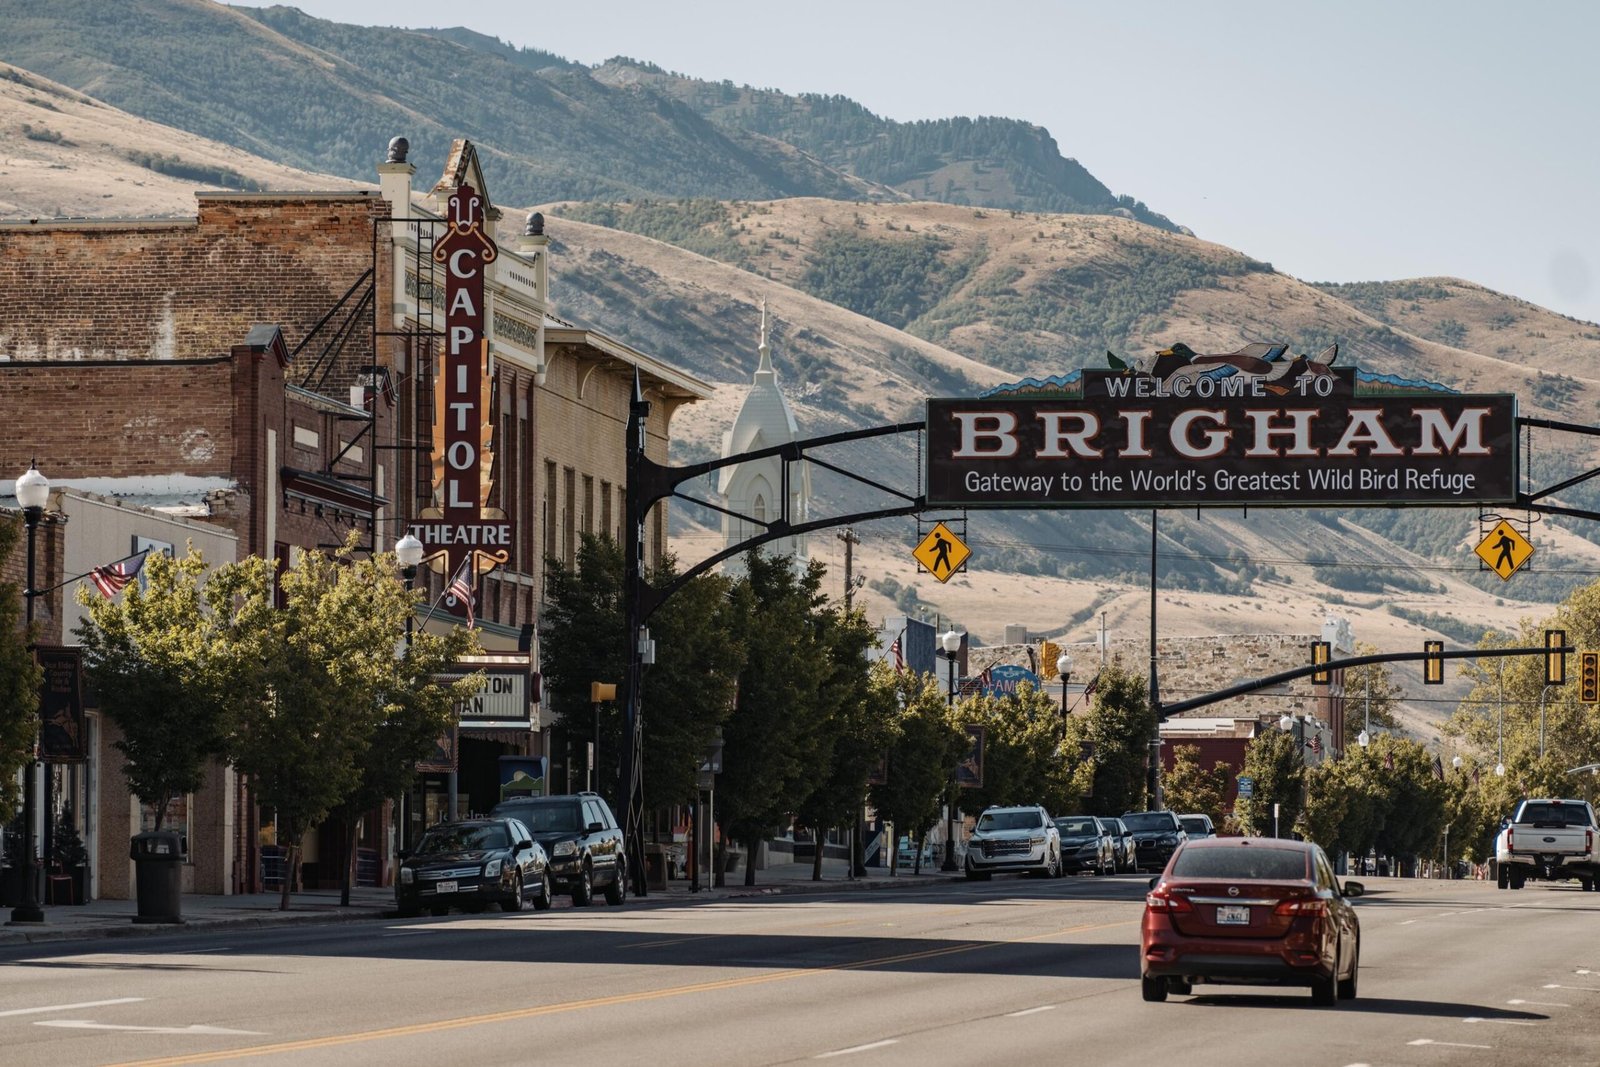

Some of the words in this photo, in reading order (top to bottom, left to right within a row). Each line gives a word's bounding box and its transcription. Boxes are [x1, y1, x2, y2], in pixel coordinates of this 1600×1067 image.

[448, 248, 477, 508] CAPITOL
[1105, 376, 1267, 398] WELCOME
[1296, 375, 1334, 397] TO
[951, 407, 1492, 460] BRIGHAM
[964, 471, 1054, 496] Gateway
[1060, 475, 1083, 492] to
[1090, 471, 1123, 491] the
[1130, 470, 1206, 492] World's
[1213, 469, 1300, 491] Greatest
[1308, 469, 1353, 490] Wild
[1359, 469, 1399, 490] Bird
[1405, 469, 1476, 495] Refuge
[410, 524, 511, 545] THEATRE
[476, 677, 513, 694] TON
[988, 679, 1019, 692] FAM
[459, 697, 484, 713] AN
[438, 809, 489, 824] Jeelry
